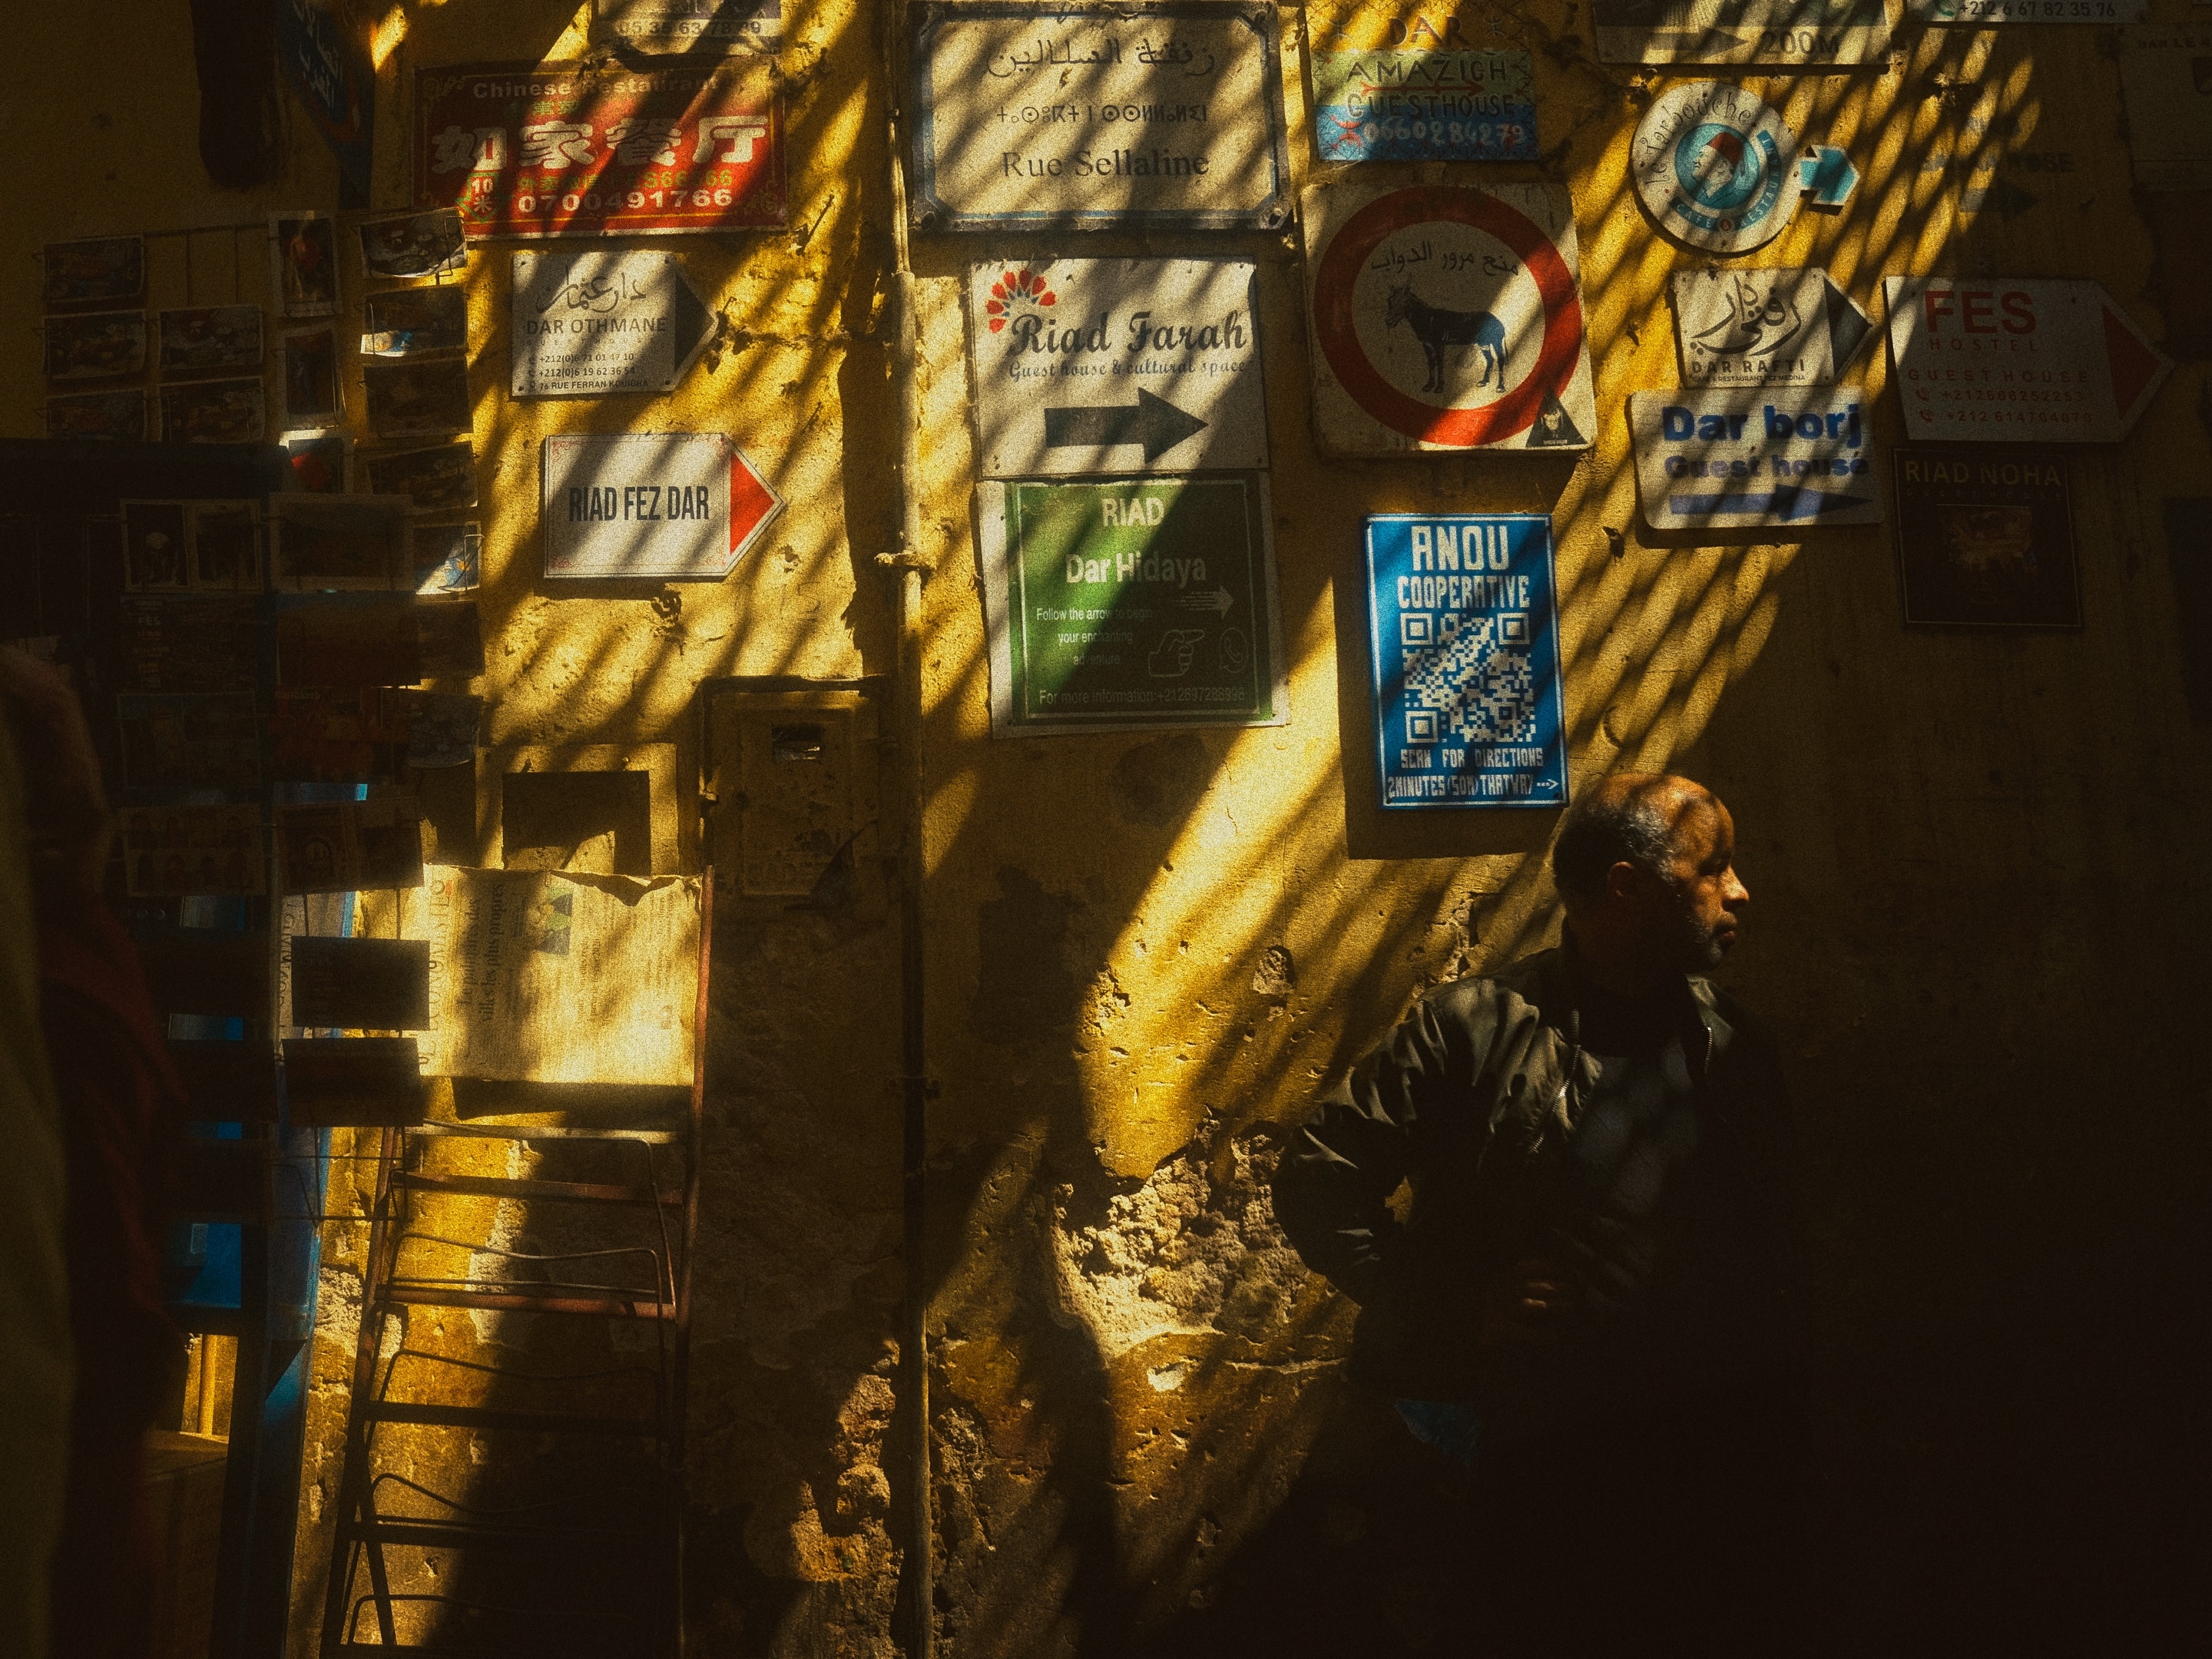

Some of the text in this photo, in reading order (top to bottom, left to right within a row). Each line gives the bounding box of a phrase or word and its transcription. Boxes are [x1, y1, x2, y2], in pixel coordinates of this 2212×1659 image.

[1959, 2, 2115, 16] +212 6 67 82 35 76
[679, 21, 701, 35] 63
[709, 21, 731, 35] 78
[1390, 16, 1469, 46] DAR
[1137, 39, 1217, 78] زنقة
[1346, 58, 1507, 82] AMAZIGH
[472, 81, 572, 100] Chinese
[1346, 94, 1516, 118] GUESTHOUSE
[431, 114, 770, 174] 如家餐厅
[1003, 150, 1210, 177] Rue Sellaline
[470, 177, 494, 195] 10
[472, 194, 495, 214] 米
[517, 188, 733, 213] 0700491766
[1370, 240, 1518, 276] منع مرور الدواب
[1923, 290, 2038, 336] FES
[526, 316, 667, 336] DAR OTHMANE
[1005, 309, 1248, 355] Riad Farah
[1929, 338, 2038, 352] HOSTEL
[1008, 359, 1250, 382] Guest house & cultural space
[1691, 358, 1805, 374] DAR RAFTI
[551, 381, 569, 390] RUE
[571, 380, 607, 389] FERRAN
[1661, 403, 1862, 449] Dar borj
[1665, 454, 1870, 478] Guest house
[1905, 460, 2062, 488] RIAD NOHA
[569, 485, 709, 522] RIAD FEZ DAR
[1101, 497, 1164, 528] RIAD
[1410, 525, 1510, 571] ANOU
[1065, 550, 1207, 589] Dar Hidaya
[1397, 575, 1531, 609] COOPERATIVE
[1036, 607, 1153, 622] Follow the arrow to begin
[1058, 631, 1134, 647] your enchanting
[1039, 689, 1058, 705] For
[1061, 691, 1091, 704] more
[1400, 747, 1544, 769] SCAN FOR DIRECTIONS
[488, 883, 507, 936] propres
[484, 939, 501, 967] plus
[480, 969, 498, 987] les
